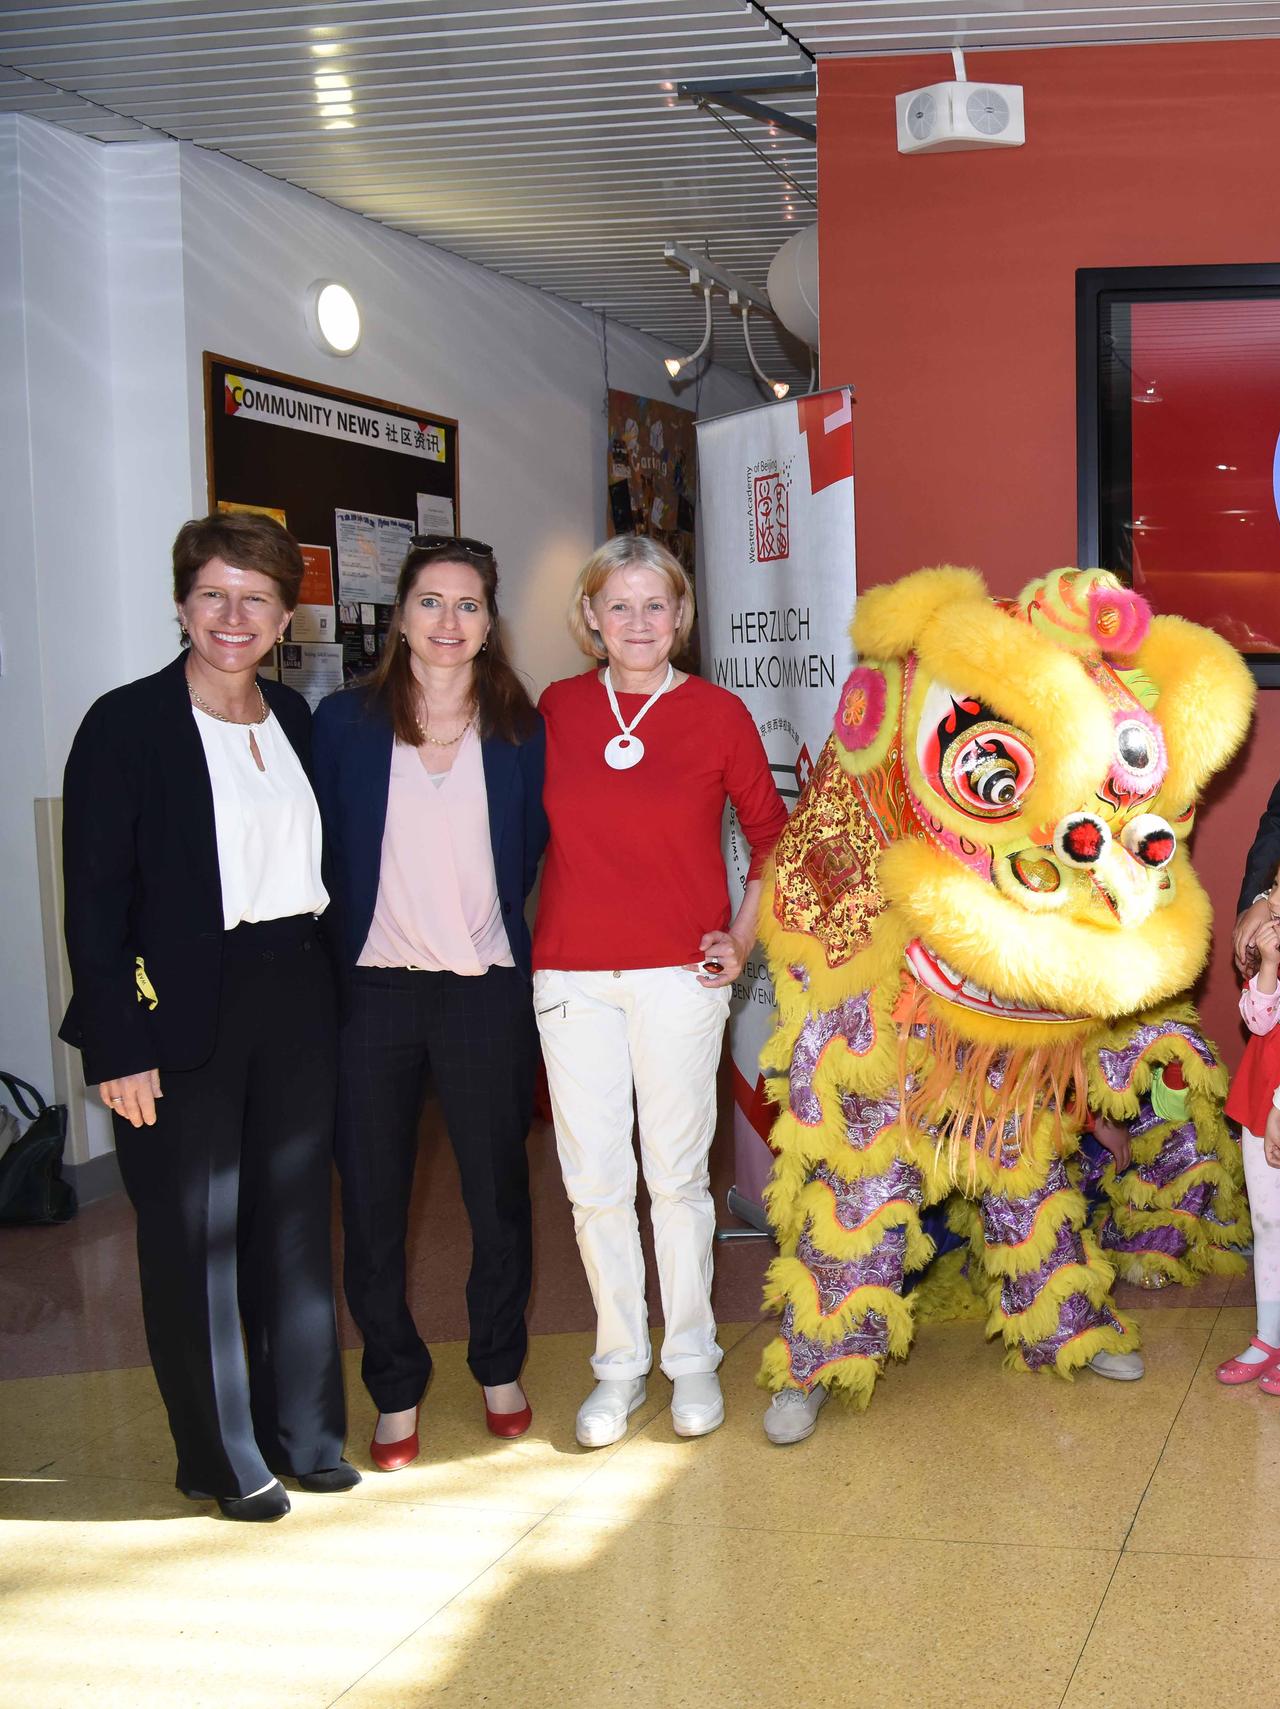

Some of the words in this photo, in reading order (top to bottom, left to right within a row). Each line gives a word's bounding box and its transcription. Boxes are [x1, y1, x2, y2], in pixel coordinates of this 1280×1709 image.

[231, 386, 333, 427] COMMUNITY
[337, 410, 380, 439] NEWS
[385, 422, 440, 453] 社区资讯
[747, 519, 756, 564] Western
[731, 608, 810, 644] HERZLICH
[714, 654, 835, 688] WILLKOMMEN
[731, 830, 739, 862] Swiss
[743, 962, 771, 982] ELC
